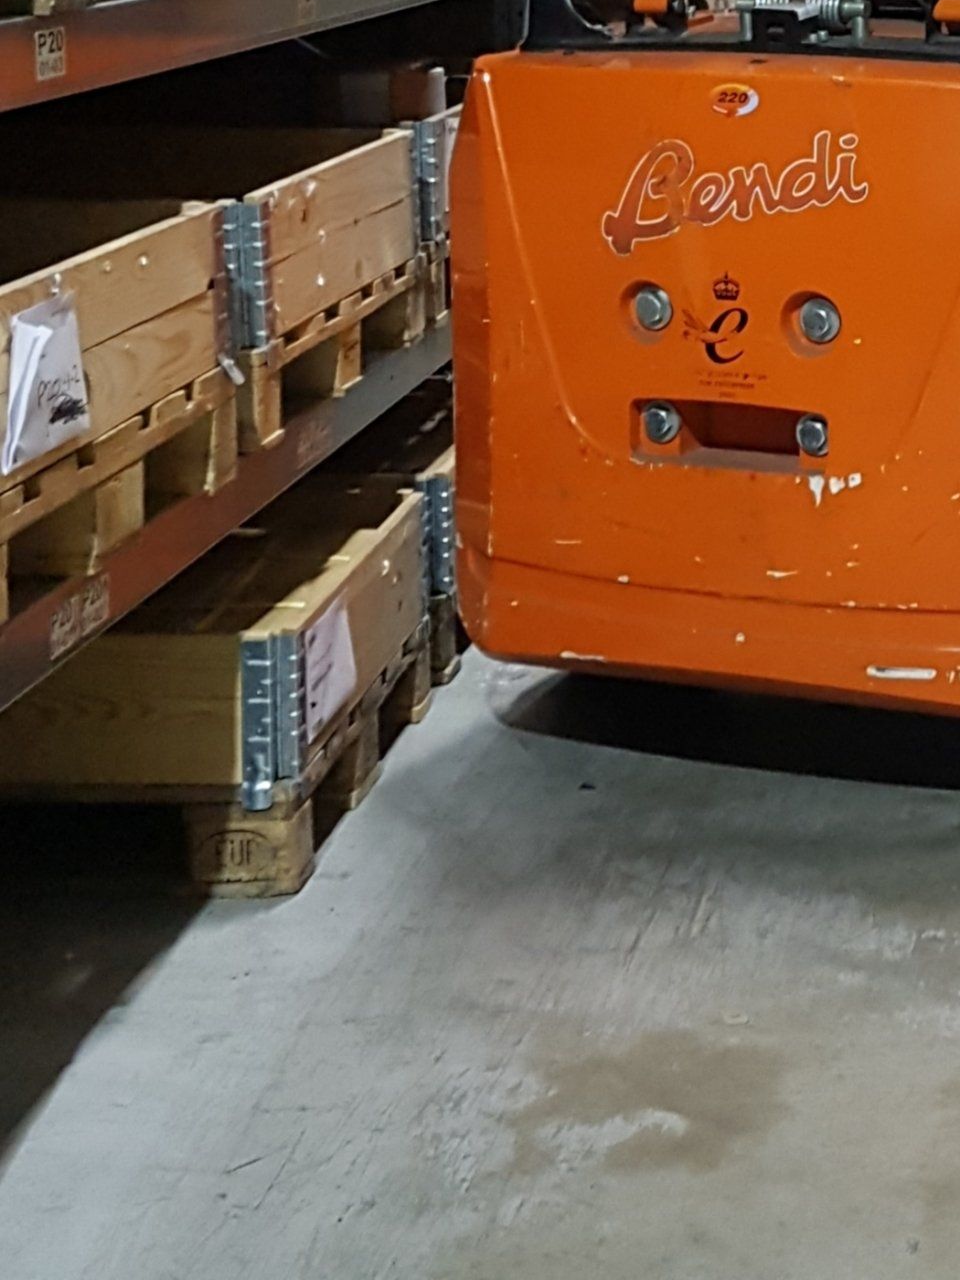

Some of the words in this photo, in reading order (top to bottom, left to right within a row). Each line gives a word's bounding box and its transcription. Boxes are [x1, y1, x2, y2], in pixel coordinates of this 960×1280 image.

[38, 30, 64, 56] P20
[717, 91, 750, 104] 220
[602, 130, 868, 257] Bendi
